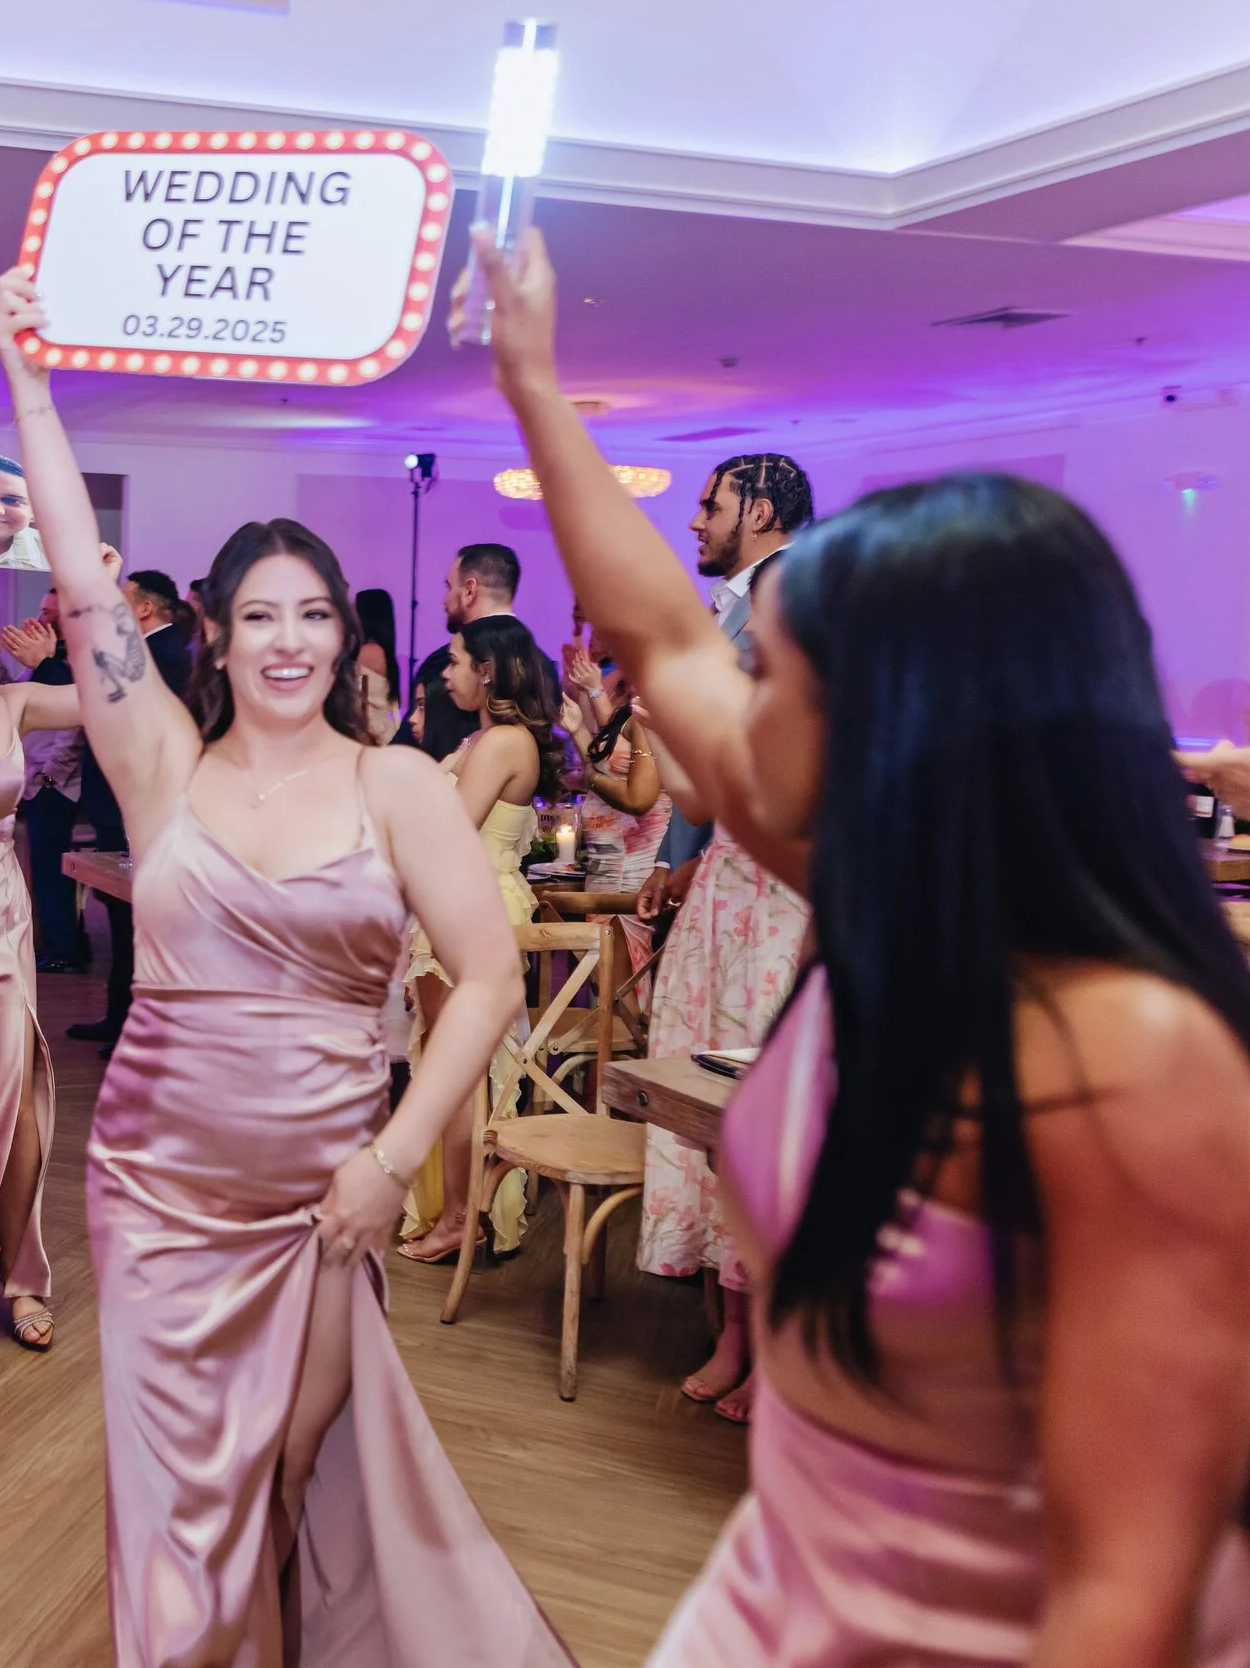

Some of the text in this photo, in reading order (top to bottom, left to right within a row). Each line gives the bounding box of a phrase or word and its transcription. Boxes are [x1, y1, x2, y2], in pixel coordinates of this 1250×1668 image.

[123, 169, 354, 207] WEDDING
[141, 217, 311, 256] OF THE
[156, 263, 275, 302] YEAR
[121, 314, 289, 345] 03.29.2025
